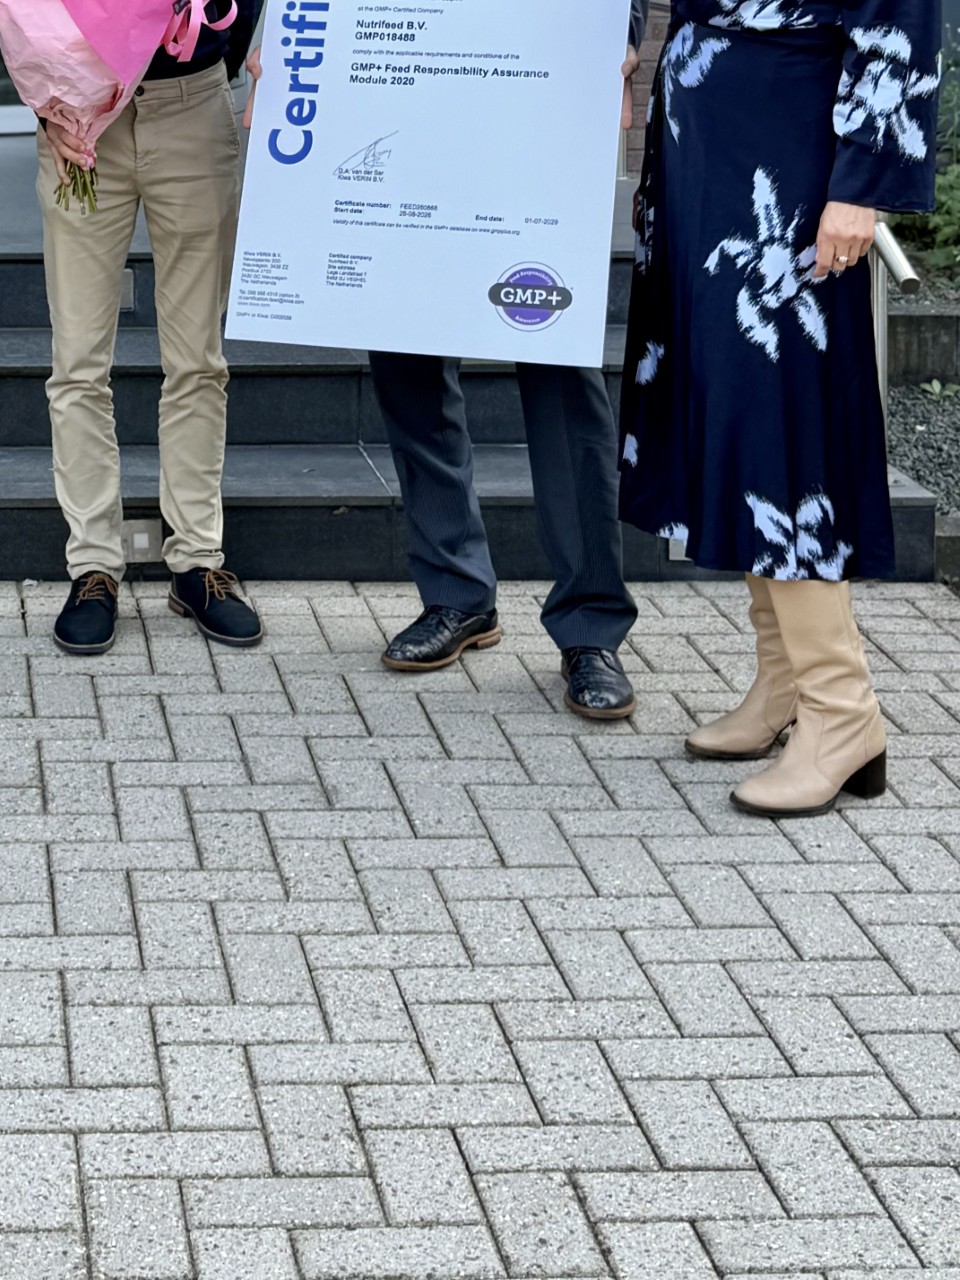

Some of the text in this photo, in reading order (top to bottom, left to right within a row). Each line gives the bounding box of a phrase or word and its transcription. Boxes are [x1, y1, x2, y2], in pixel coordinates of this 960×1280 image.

[356, 19, 427, 30] Nutrifeed B.V.
[351, 62, 549, 78] GMP+ Feed Responsibility Assurance
[349, 74, 414, 85] Module 2020
[500, 287, 561, 305] GMP+
